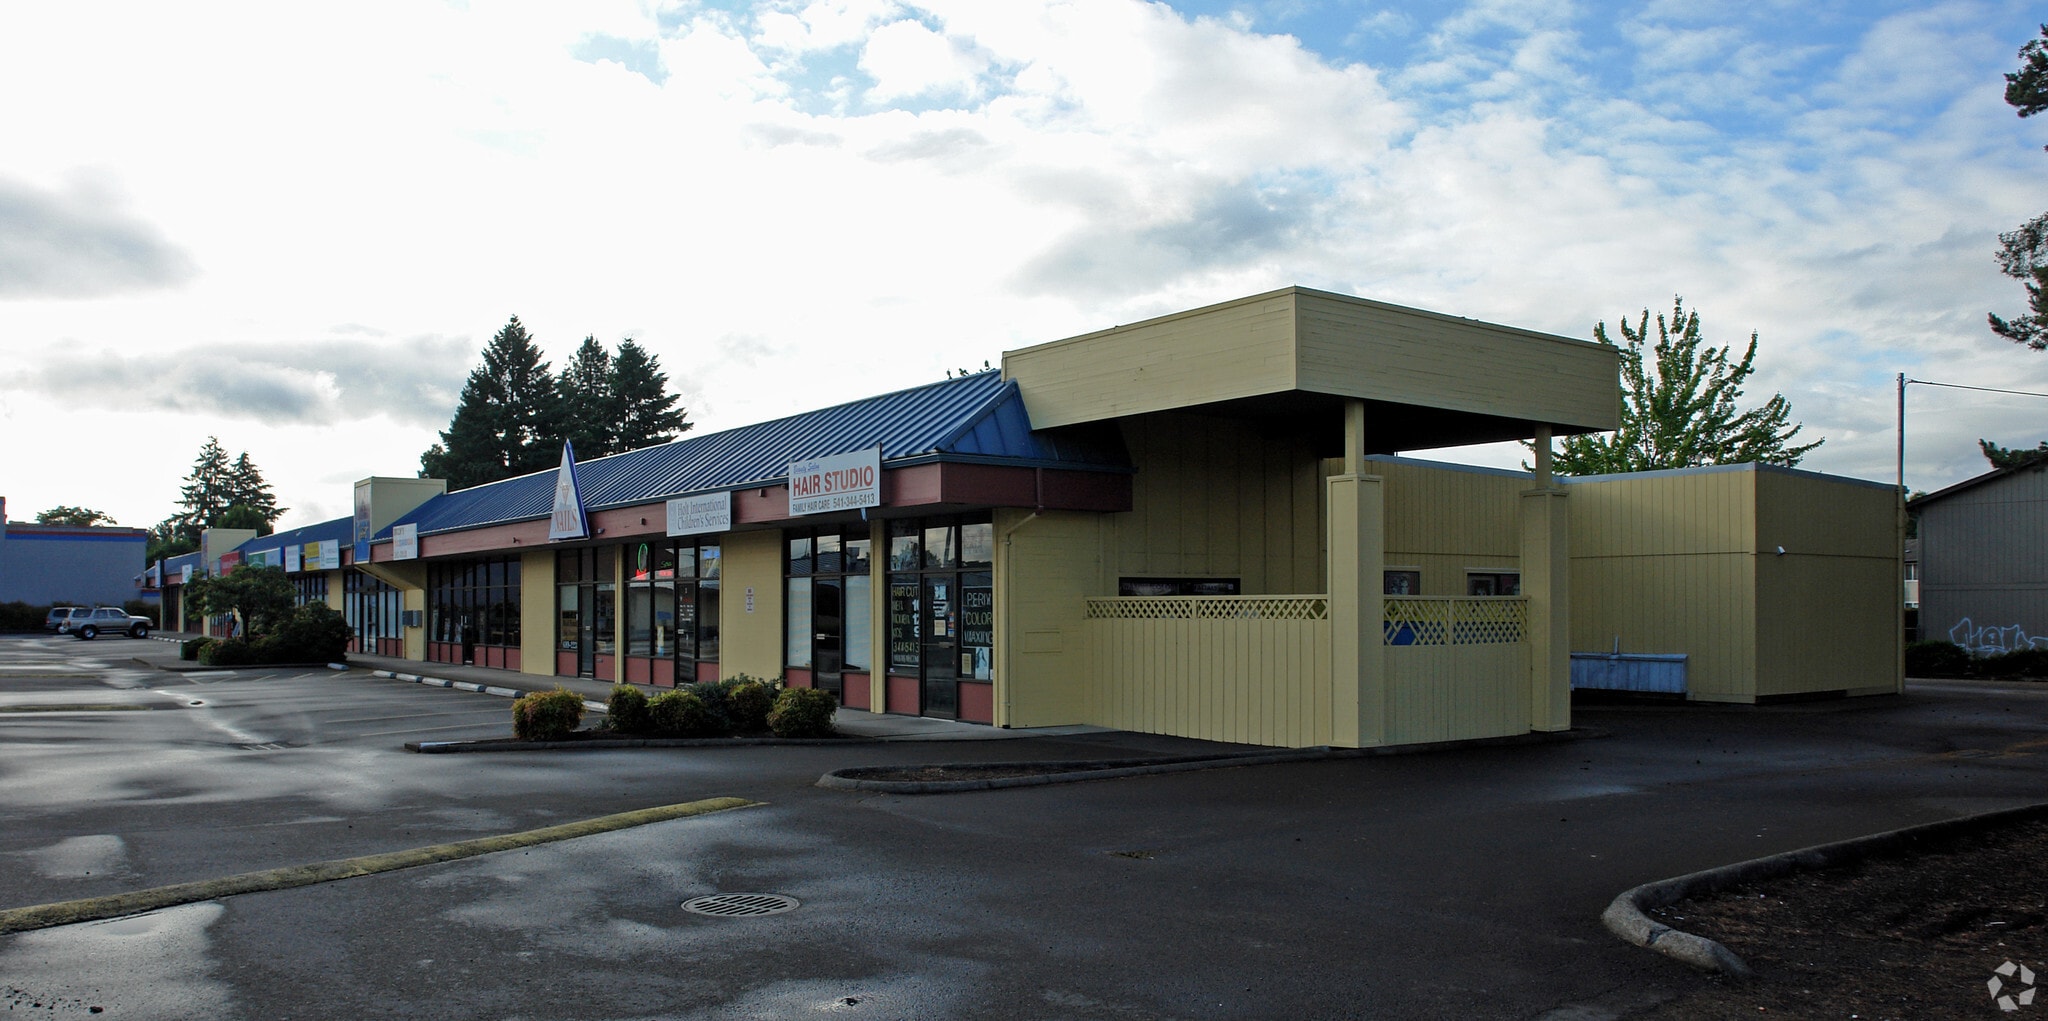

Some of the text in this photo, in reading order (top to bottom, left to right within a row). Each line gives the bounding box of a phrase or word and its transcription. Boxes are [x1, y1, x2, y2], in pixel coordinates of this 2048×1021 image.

[793, 465, 874, 496] HAIR STUDIO
[677, 496, 726, 517] Holt International
[792, 493, 875, 513] FAMILY HAIR CARE 541-344-5413
[555, 508, 578, 532] NAILS
[677, 512, 729, 530] Children's Services
[905, 585, 918, 597] CUT
[965, 612, 993, 625] COLOR
